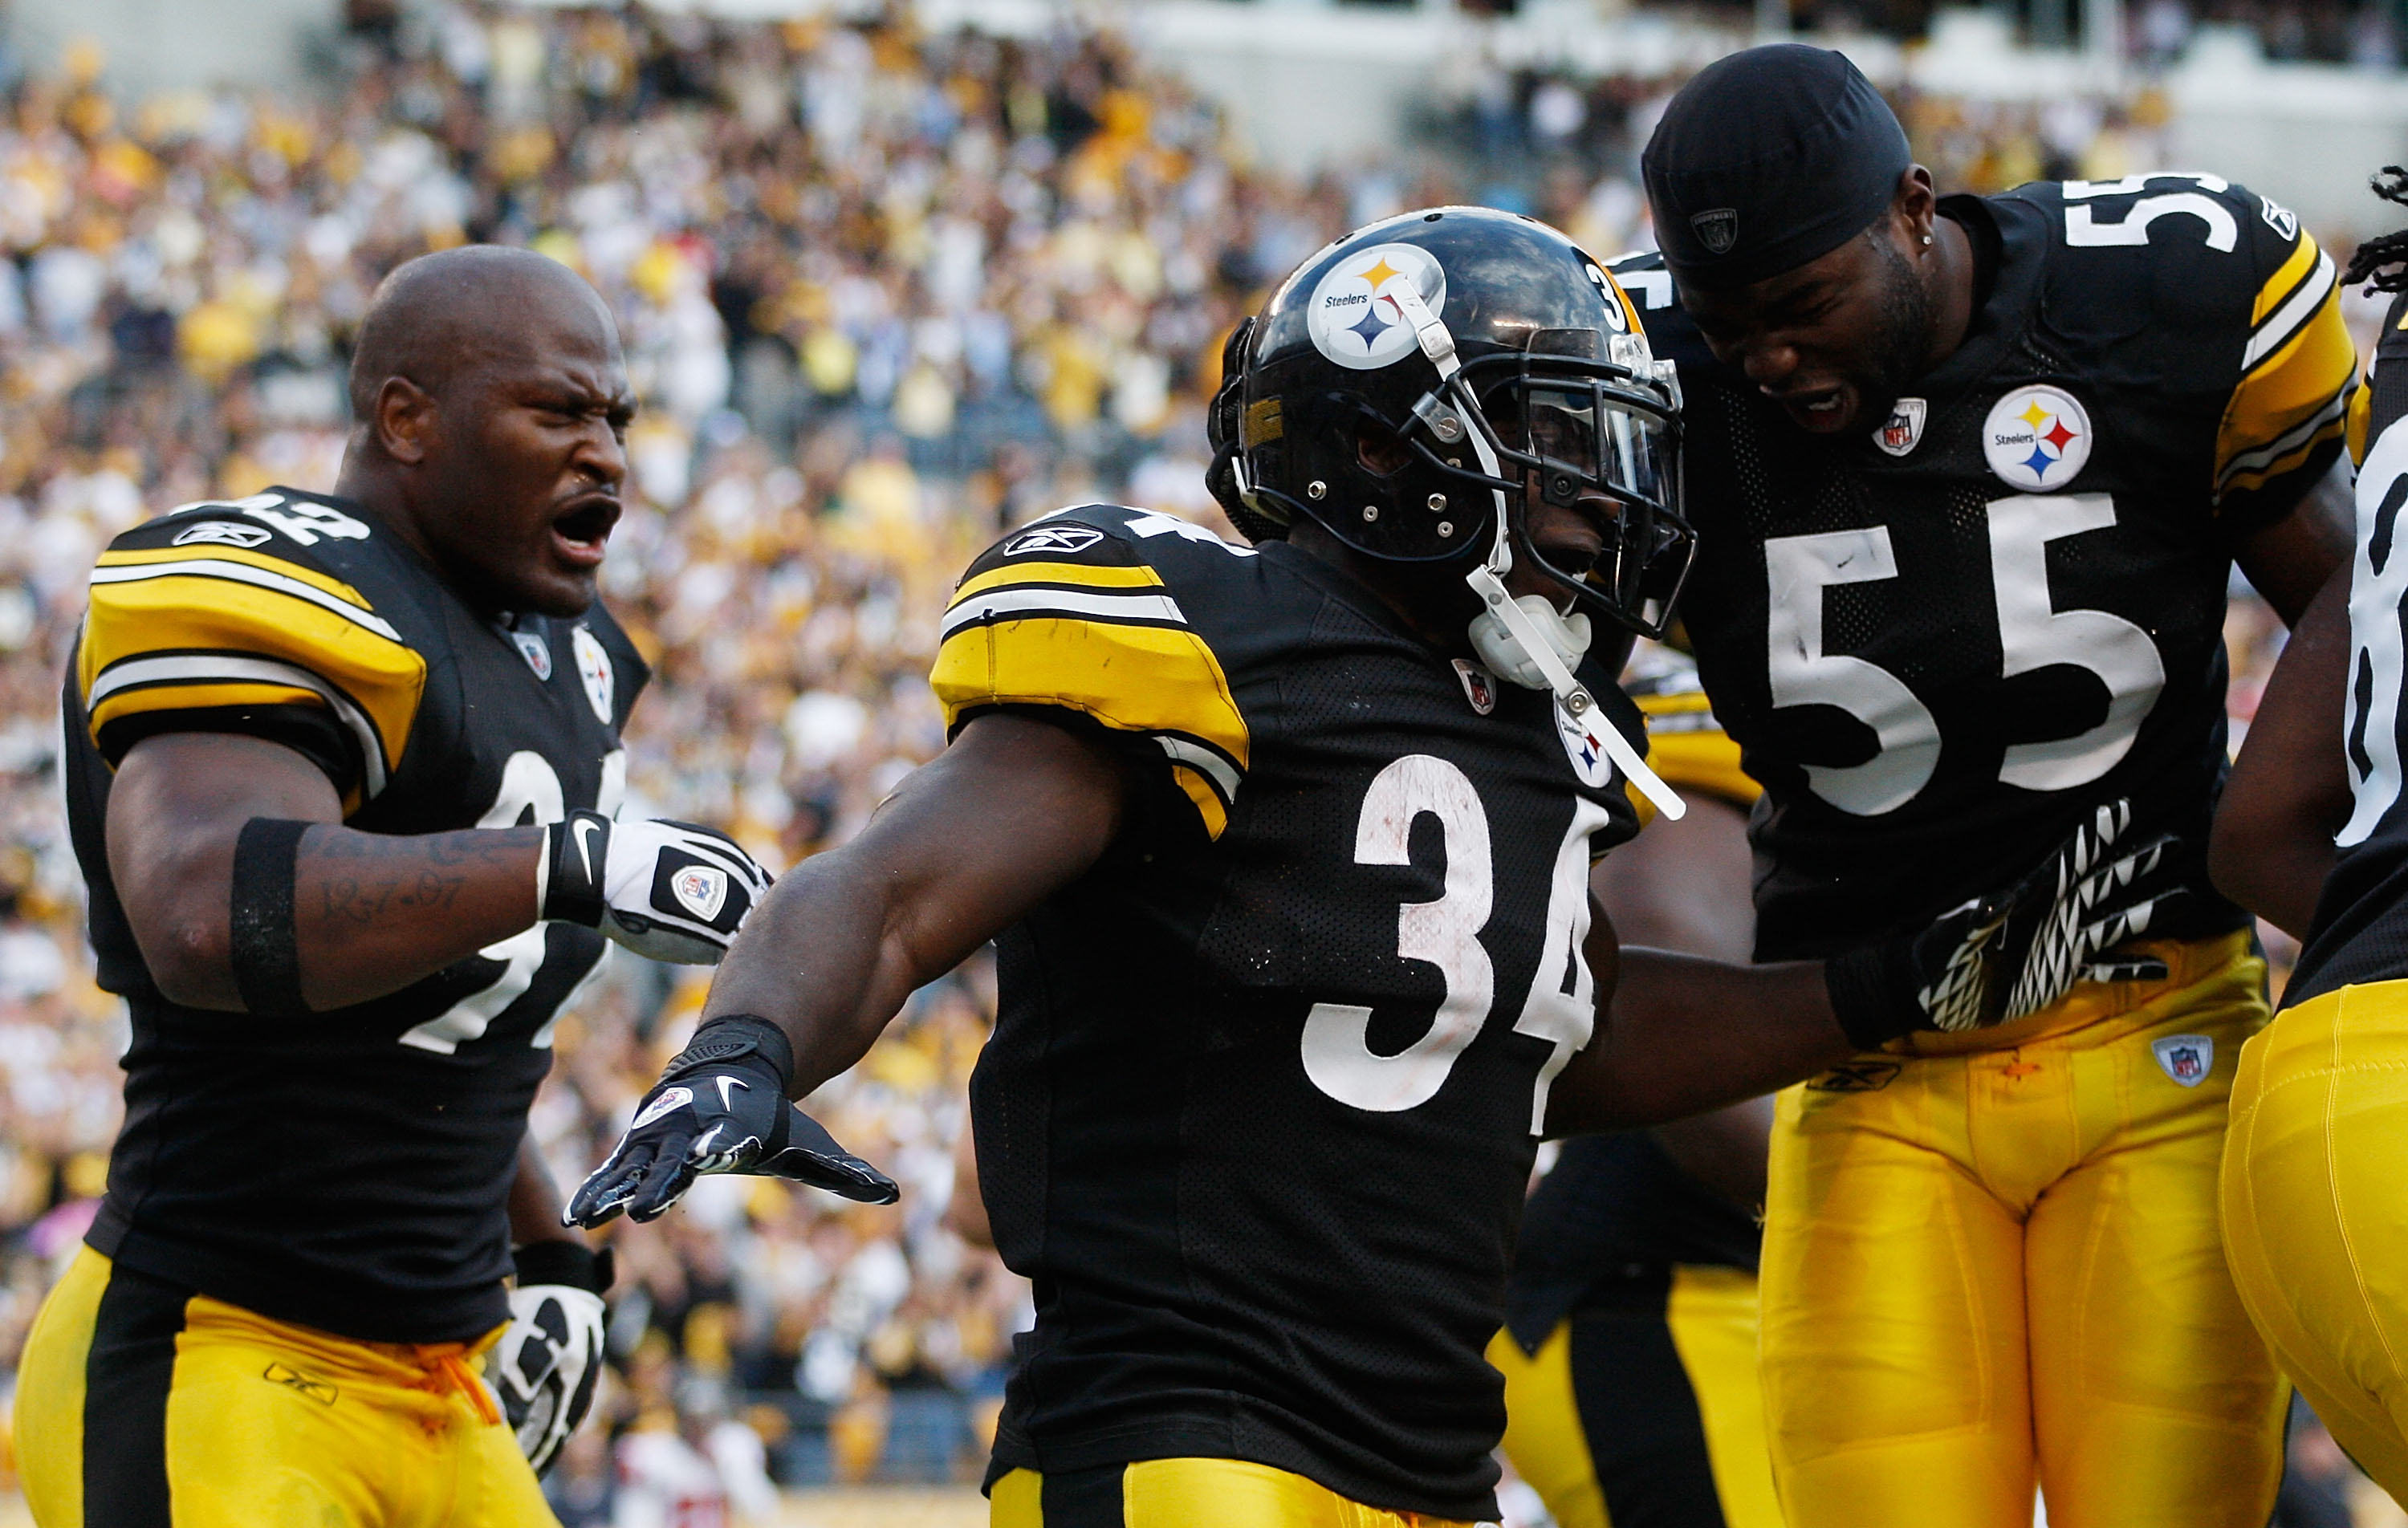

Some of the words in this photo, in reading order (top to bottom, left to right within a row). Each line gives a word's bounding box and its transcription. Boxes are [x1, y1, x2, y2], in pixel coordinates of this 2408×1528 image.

[1324, 293, 1368, 308] Steelers
[1885, 427, 1911, 446] NFL
[1995, 433, 2034, 446] Steelers
[1764, 492, 2166, 816] 55
[1300, 754, 1609, 1136] 34
